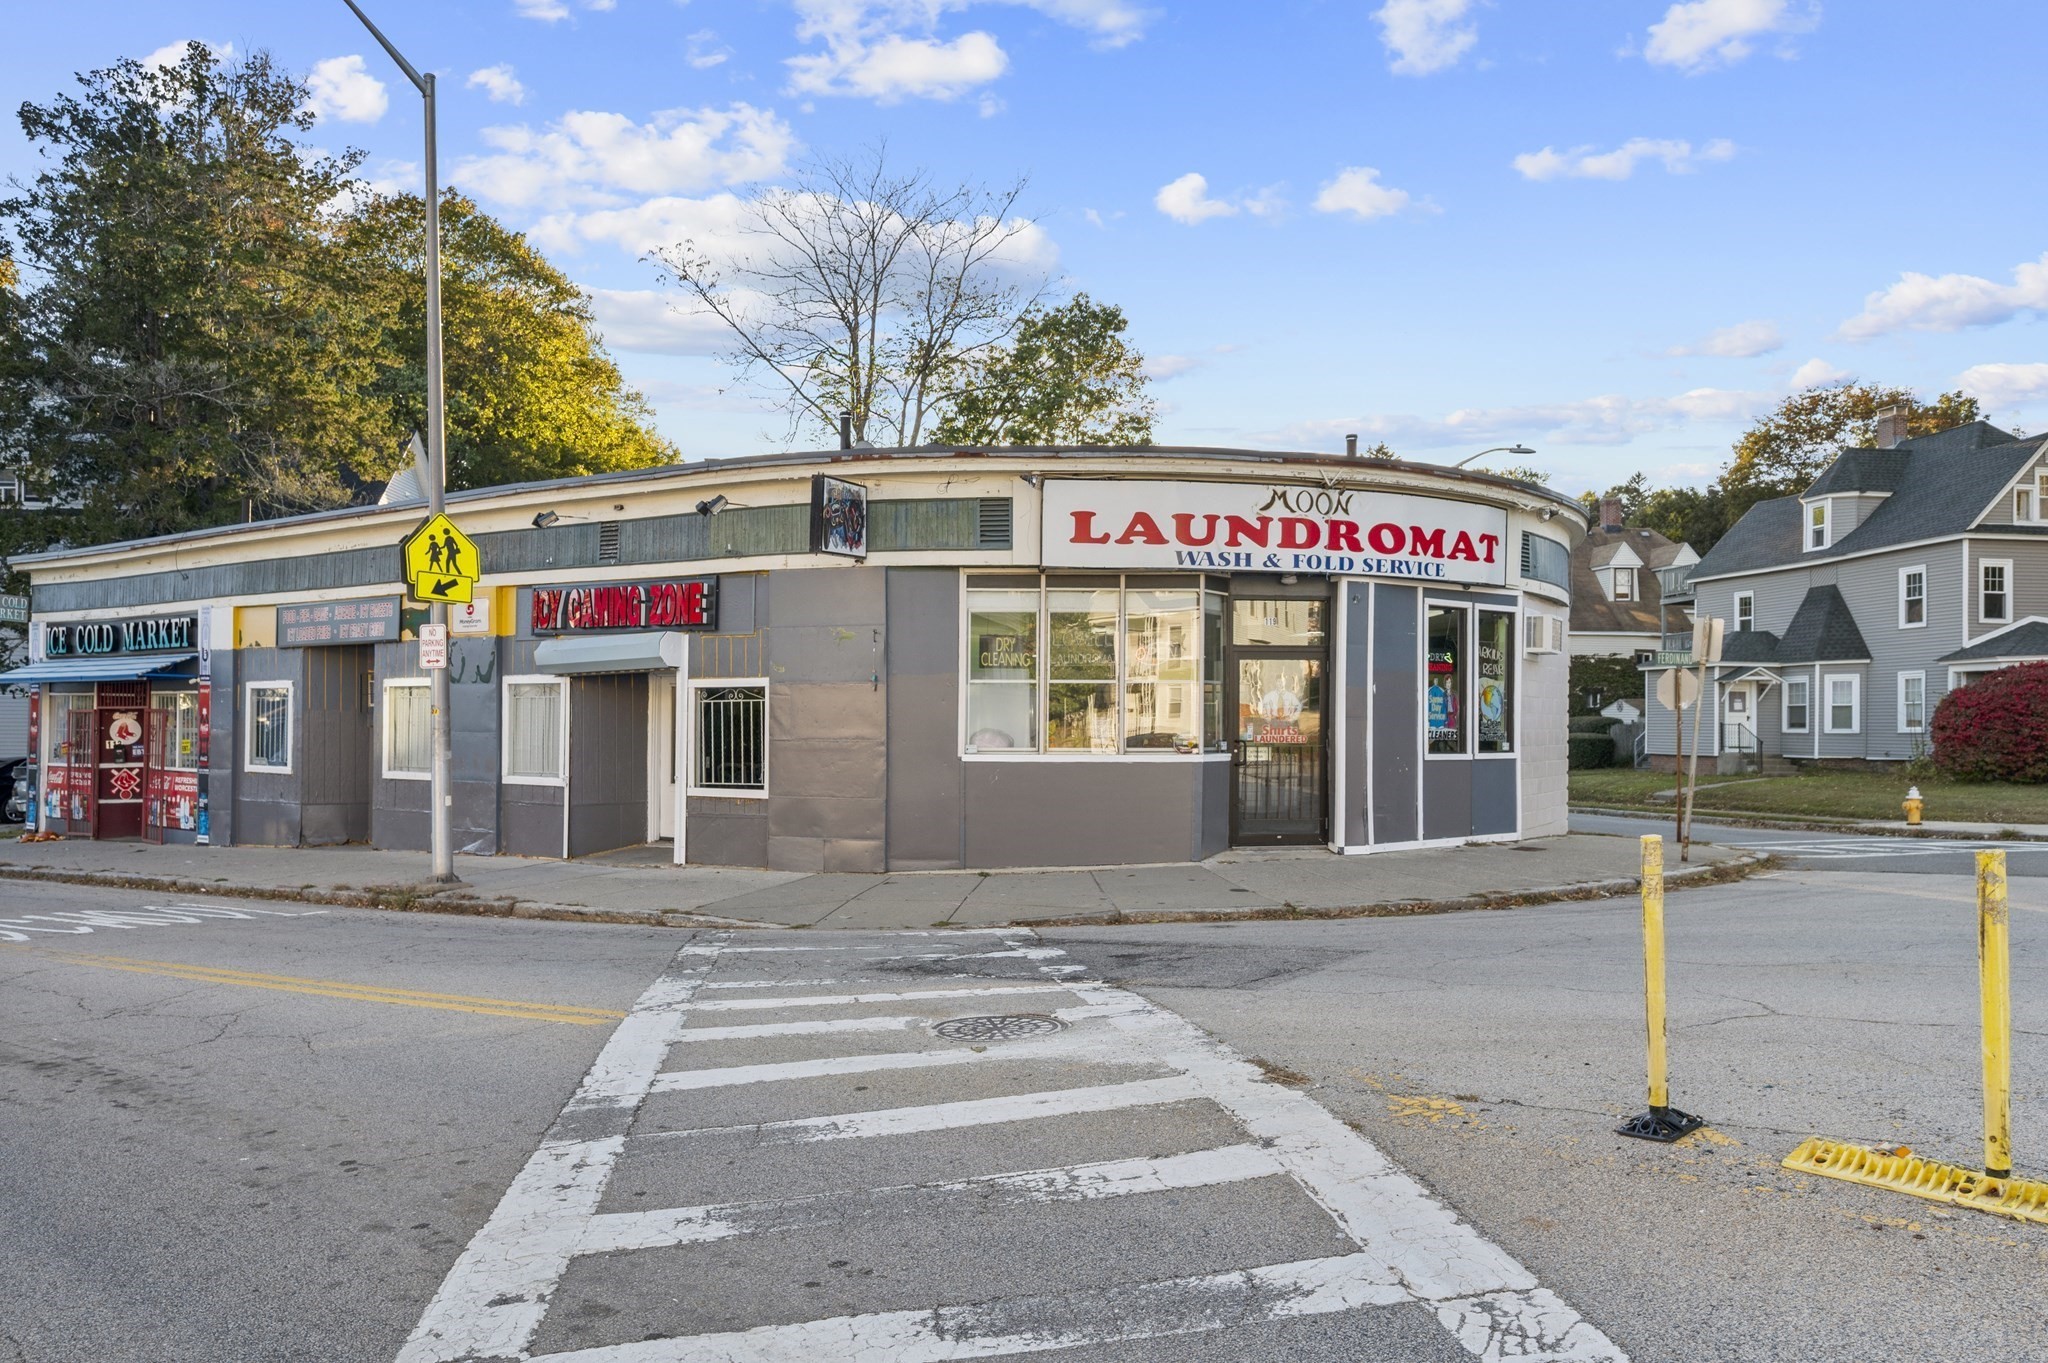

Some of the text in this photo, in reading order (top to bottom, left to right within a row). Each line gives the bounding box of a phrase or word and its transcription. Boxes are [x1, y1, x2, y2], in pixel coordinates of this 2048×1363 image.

[1259, 488, 1353, 516] MOON
[1069, 510, 1499, 564] LAUNDROMAT
[1174, 550, 1445, 578] WASH & FOLD SERVICE
[2, 596, 28, 609] COLD
[532, 582, 707, 629] ICY GAMING ZONE
[1264, 617, 1278, 626] 119
[46, 617, 192, 655] ICE COLD MARKET
[428, 628, 437, 637] NO
[422, 639, 444, 647] PARKING
[996, 637, 1016, 652] DRY
[422, 649, 444, 658] ANYTIME
[1430, 653, 1445, 661] DRY
[981, 653, 1031, 668] CLEANING
[1482, 662, 1504, 675] REAR
[1431, 703, 1442, 712] Day
[1262, 724, 1298, 736] Shirts
[1253, 735, 1308, 744] LAUNDERED
